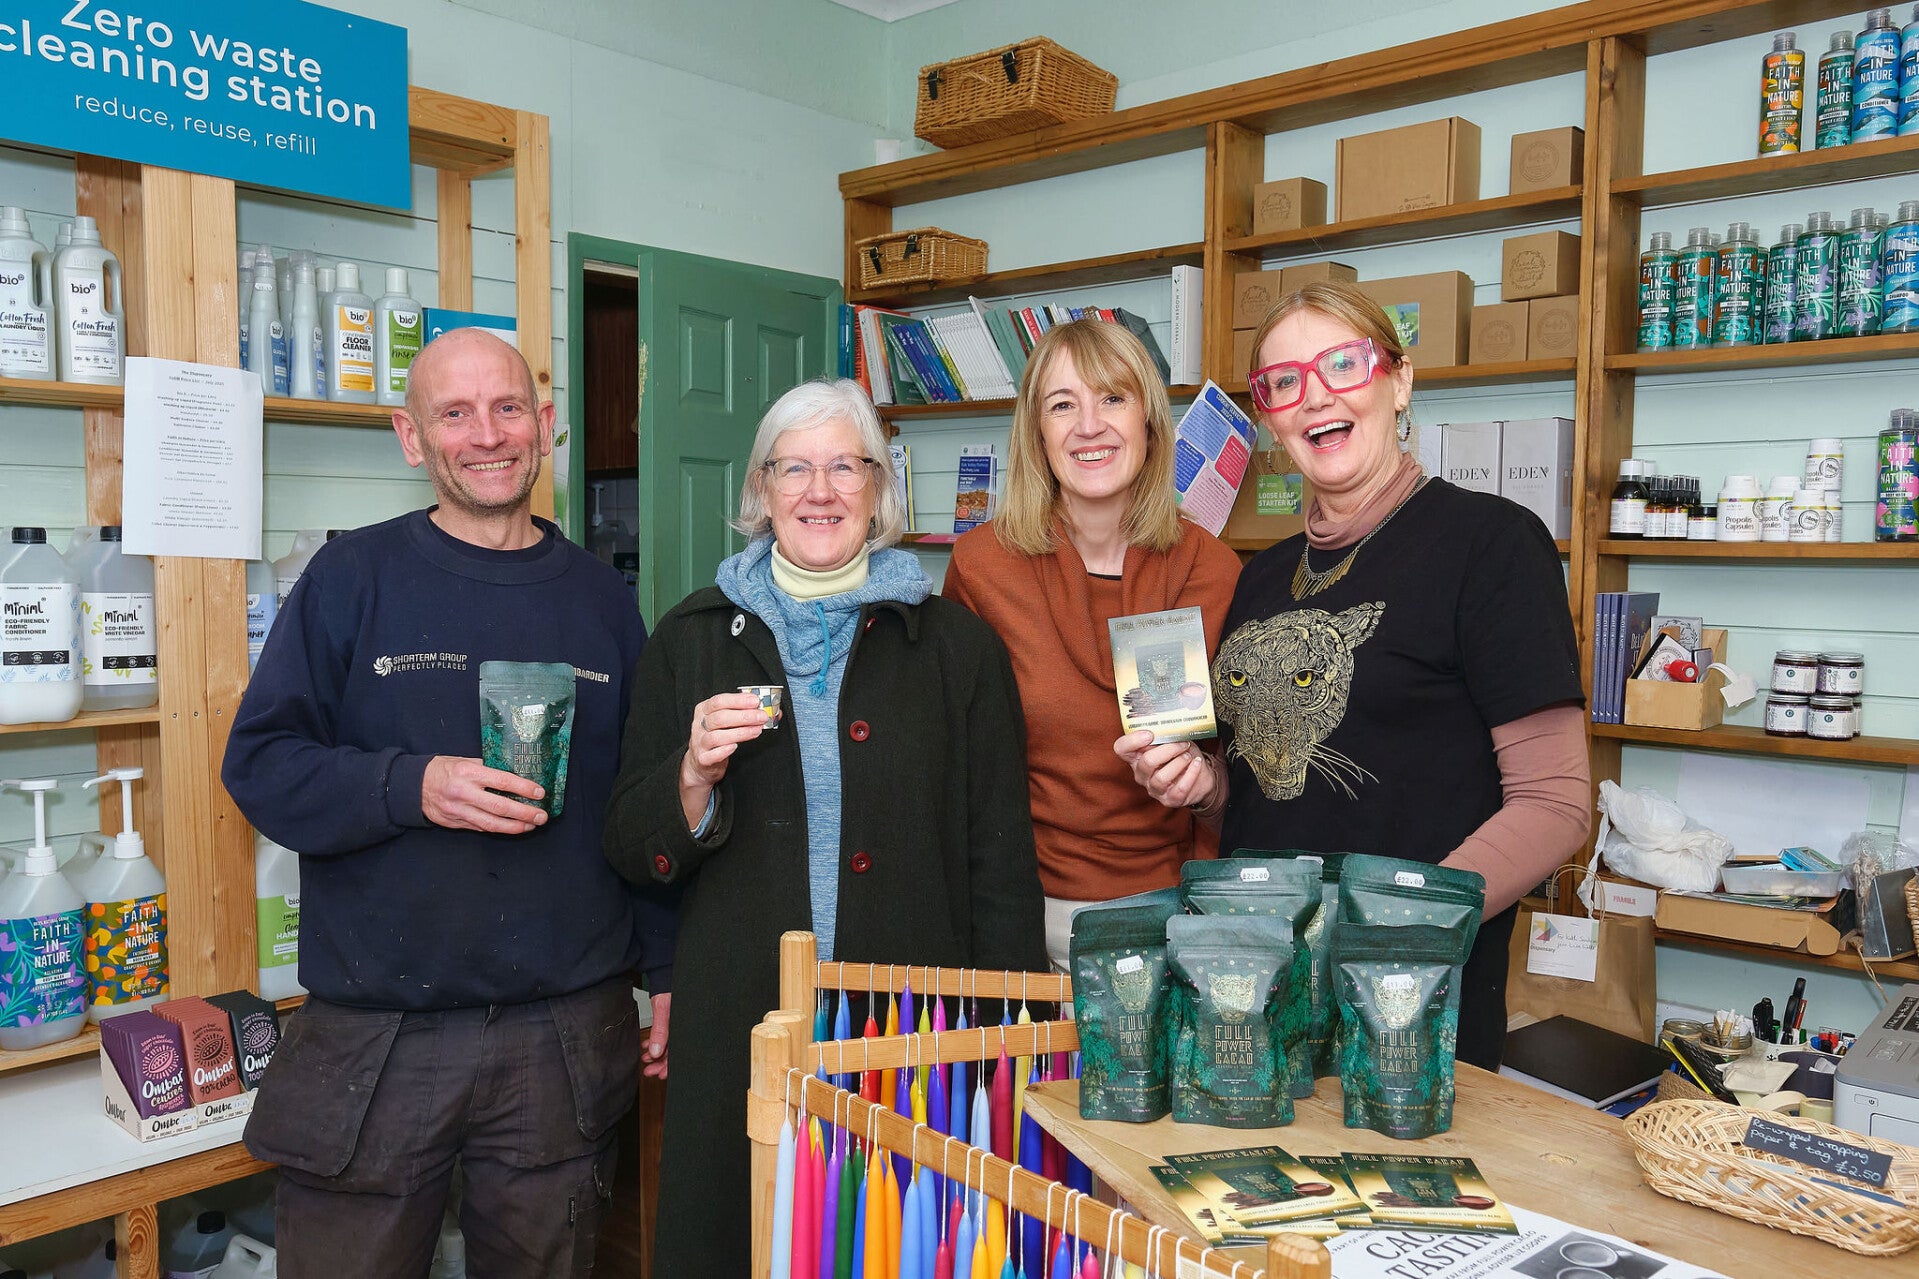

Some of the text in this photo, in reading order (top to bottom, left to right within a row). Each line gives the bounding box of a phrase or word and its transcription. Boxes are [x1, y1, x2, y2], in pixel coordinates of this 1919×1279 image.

[61, 0, 322, 83] Zero waste
[1861, 44, 1894, 58] FAITH
[0, 20, 376, 130] cleaning station
[1769, 66, 1799, 80] FAITH
[1820, 68, 1851, 83] FAITH
[1860, 69, 1893, 84] NATURE
[1905, 66, 1919, 77] NAT
[1767, 90, 1798, 104] NATURE
[1819, 91, 1850, 106] NATURE
[75, 91, 316, 156] reduce, reuse, refill
[1841, 243, 1872, 258] FAITH
[1887, 237, 1917, 251] FAITH
[1797, 249, 1820, 261] AITH
[1721, 258, 1752, 271] FAITH
[1886, 262, 1916, 276] NATURE
[1642, 266, 1672, 279] FAITH
[1841, 268, 1871, 283] NATURE
[71, 283, 91, 294] bio
[1721, 282, 1751, 294] NATURE
[1642, 289, 1671, 301] NATURE
[24, 312, 45, 325] Fresh
[350, 311, 365, 321] bio
[399, 315, 413, 324] bio
[72, 320, 116, 333] Cotton Fresh
[1396, 322, 1411, 330] EAF
[342, 342, 372, 353] CLEANER
[346, 336, 369, 346] FLOOR
[1881, 448, 1914, 459] FAITH
[1450, 468, 1489, 480] EDEN
[1509, 466, 1549, 480] EDEN
[1881, 473, 1913, 484] NATURE
[1725, 516, 1753, 525] Propolis
[1725, 523, 1754, 531] Capsules
[393, 652, 468, 665] SHORTERM GROUP
[393, 661, 467, 673] PERFECTLY PLACED
[515, 743, 542, 755] FULL
[515, 755, 542, 764] POWER
[514, 764, 542, 774] CACAO
[1242, 871, 1269, 881] £22.00
[1397, 874, 1424, 888] £22.00
[124, 906, 158, 923] FAITH
[33, 922, 70, 941] FAITH
[125, 931, 159, 949] NATURE
[34, 949, 71, 969] NATURE
[1119, 1013, 1153, 1032] FULL
[1120, 1031, 1149, 1044] POWE
[1215, 1024, 1252, 1041] FULL
[1380, 1031, 1418, 1047] FULL
[1121, 1044, 1149, 1057] CACA
[1215, 1040, 1252, 1053] POWER
[1215, 1053, 1253, 1065] CACAO
[1380, 1048, 1418, 1060] POWER
[244, 1052, 274, 1072] Omb
[1380, 1060, 1418, 1073] CACAO
[193, 1056, 234, 1086] Ombar
[142, 1068, 184, 1099] Ombar
[200, 1074, 236, 1097] 90% CACAO
[105, 1095, 126, 1123] Ombar
[1750, 1128, 1783, 1144] paper
[1752, 1118, 1870, 1165] Re-wrapped wrapping
[1202, 1151, 1238, 1162] POWER
[1382, 1155, 1421, 1165] POWER
[1835, 1160, 1882, 1183] £2.50
[1514, 1230, 1537, 1244] CACAO
[1522, 1234, 1549, 1250] COOPER
[1366, 1230, 1446, 1260] CAC
